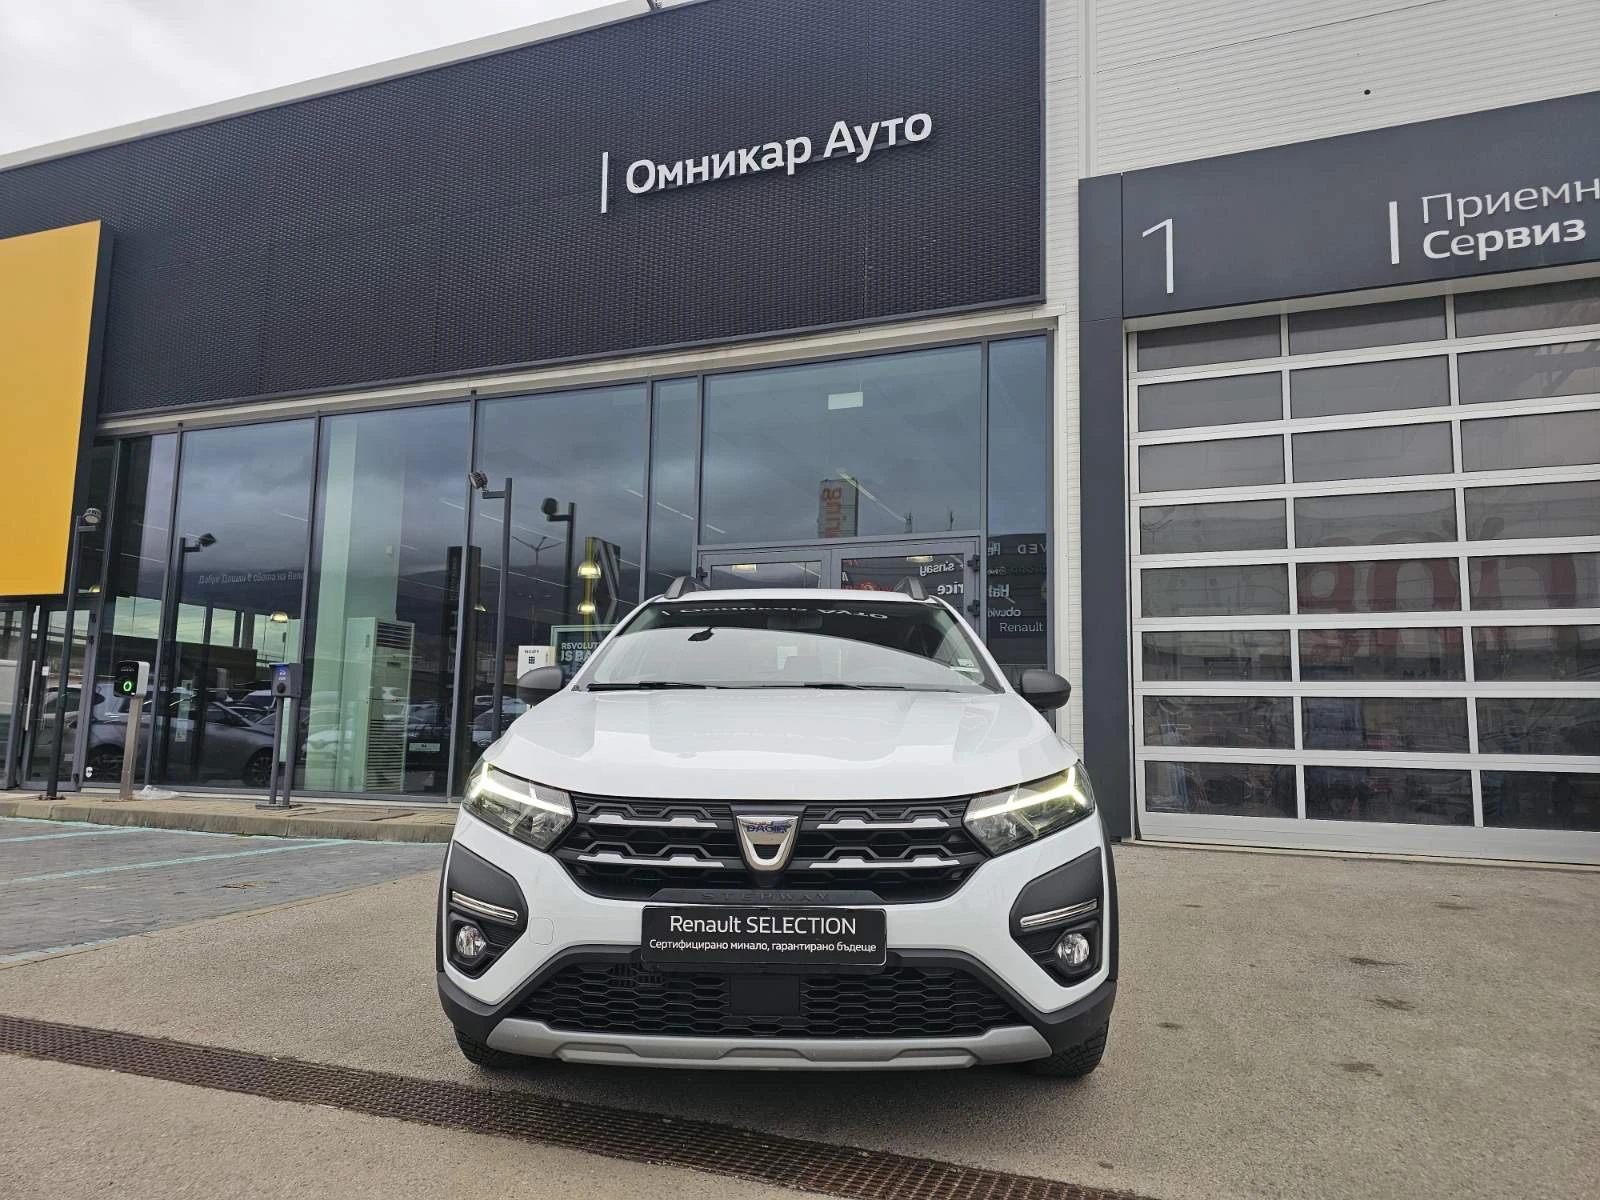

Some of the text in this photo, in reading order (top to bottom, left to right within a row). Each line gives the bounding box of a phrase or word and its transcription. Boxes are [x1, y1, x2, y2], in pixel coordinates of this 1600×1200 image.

[626, 113, 933, 194] Омникар Ауто
[1421, 178, 1600, 227] Приемн
[1141, 218, 1175, 294] 1
[1423, 219, 1586, 261] Сервиз
[999, 621, 1044, 632] Renault
[649, 939, 877, 953] Сертифицирано минало, гарантирано бъдеще
[670, 915, 857, 935] Renault SELECTION
